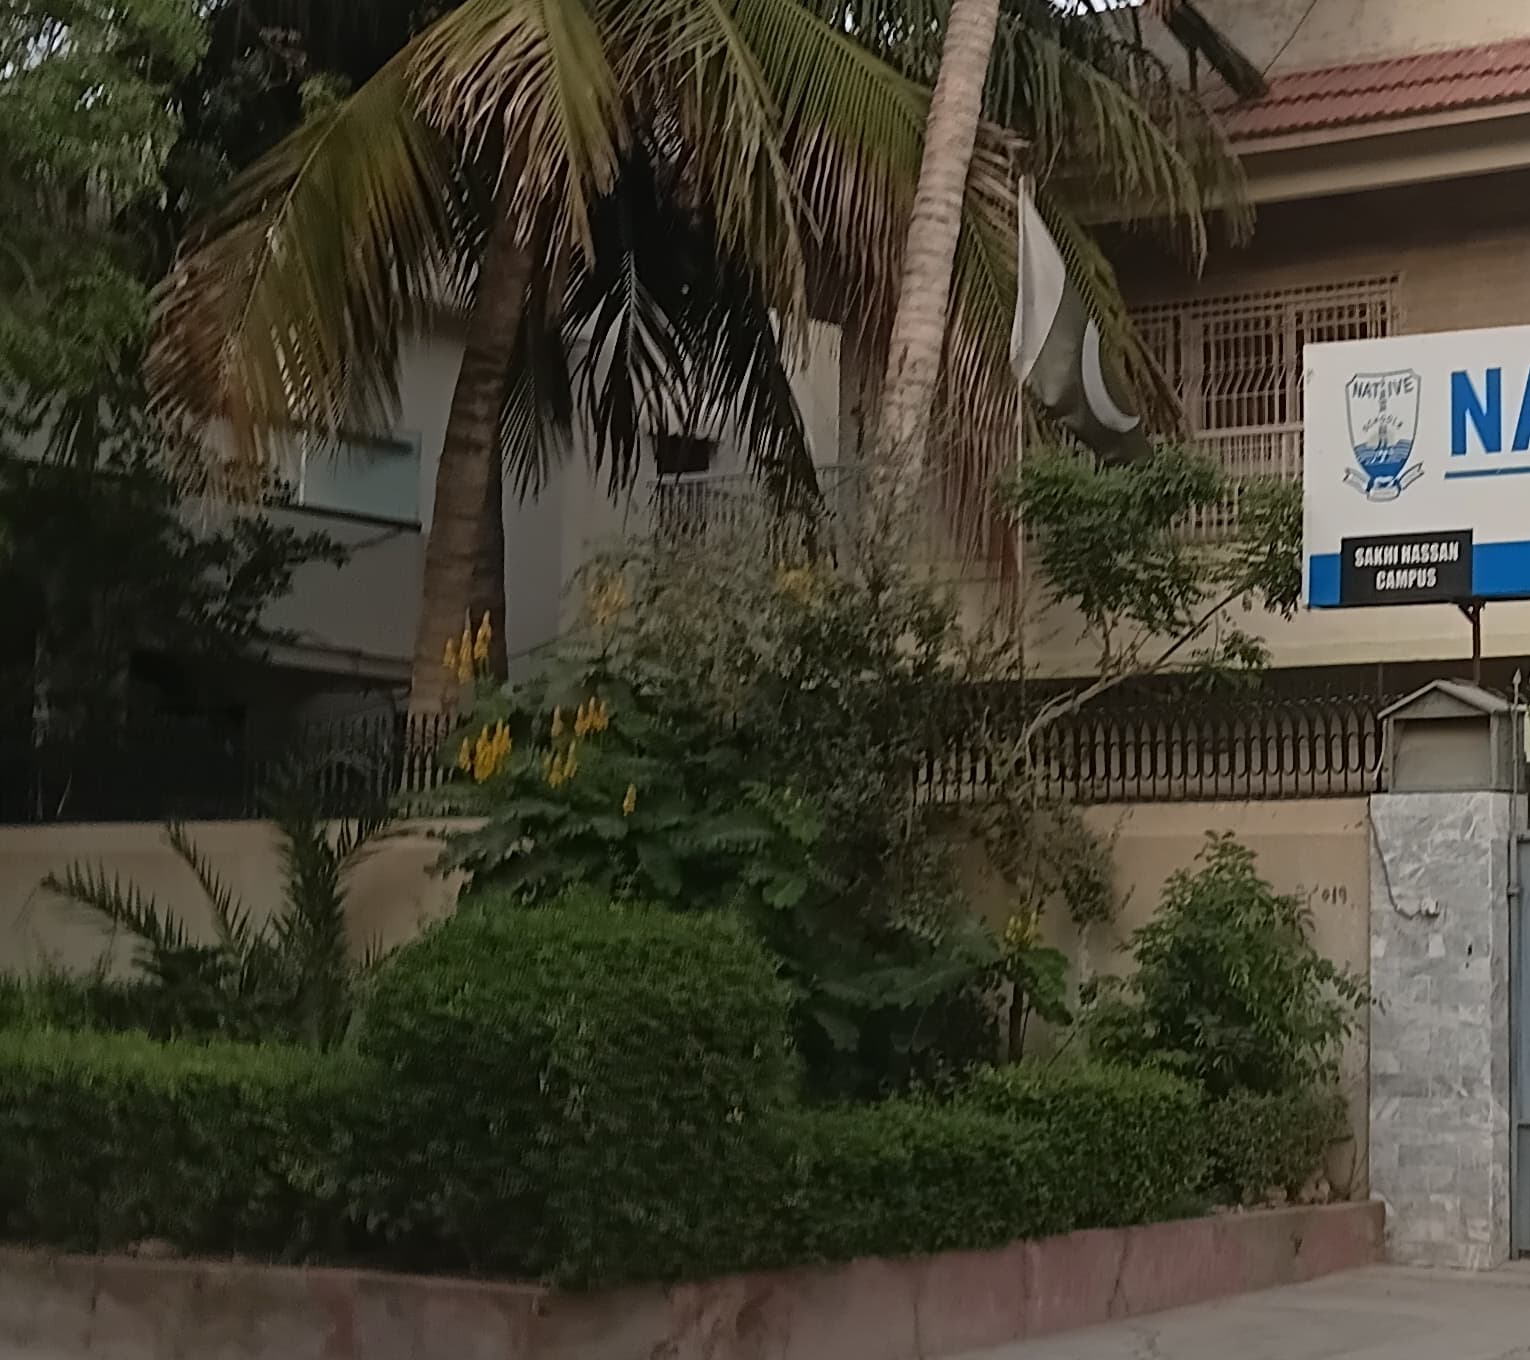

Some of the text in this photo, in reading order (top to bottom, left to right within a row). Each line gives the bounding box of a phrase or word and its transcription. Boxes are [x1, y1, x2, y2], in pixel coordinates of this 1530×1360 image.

[1352, 375, 1414, 398] NATIVE
[1354, 541, 1460, 568] SAKHI HASSAN
[1375, 567, 1437, 591] CAMPUS
